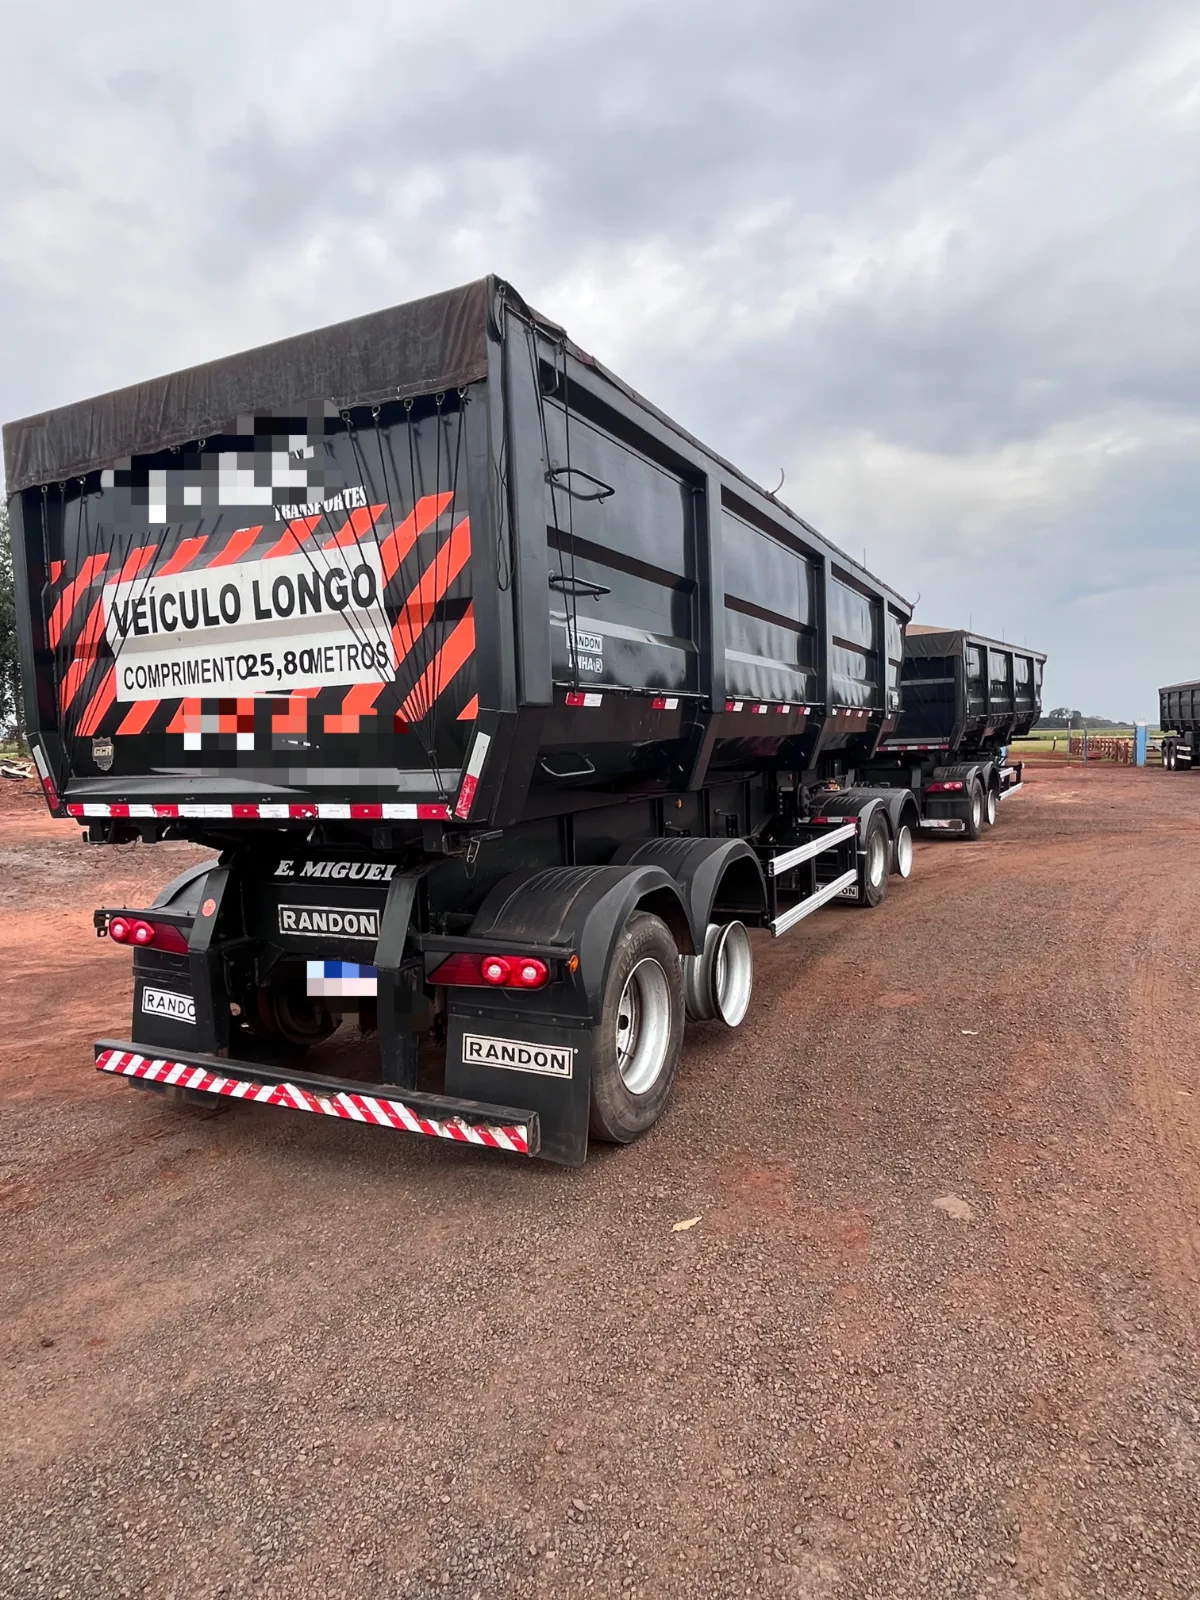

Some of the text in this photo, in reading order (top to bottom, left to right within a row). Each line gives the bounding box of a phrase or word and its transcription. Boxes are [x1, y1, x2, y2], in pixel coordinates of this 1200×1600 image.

[273, 486, 367, 521] TRANSPORTES
[112, 564, 376, 638] VEÍCULO LONGO
[124, 641, 388, 690] COMPRIMENTO 25,80 METROS
[274, 860, 295, 876] E.
[282, 910, 376, 935] RANDON
[147, 993, 197, 1017] RANDO
[469, 1041, 566, 1070] RANDON
